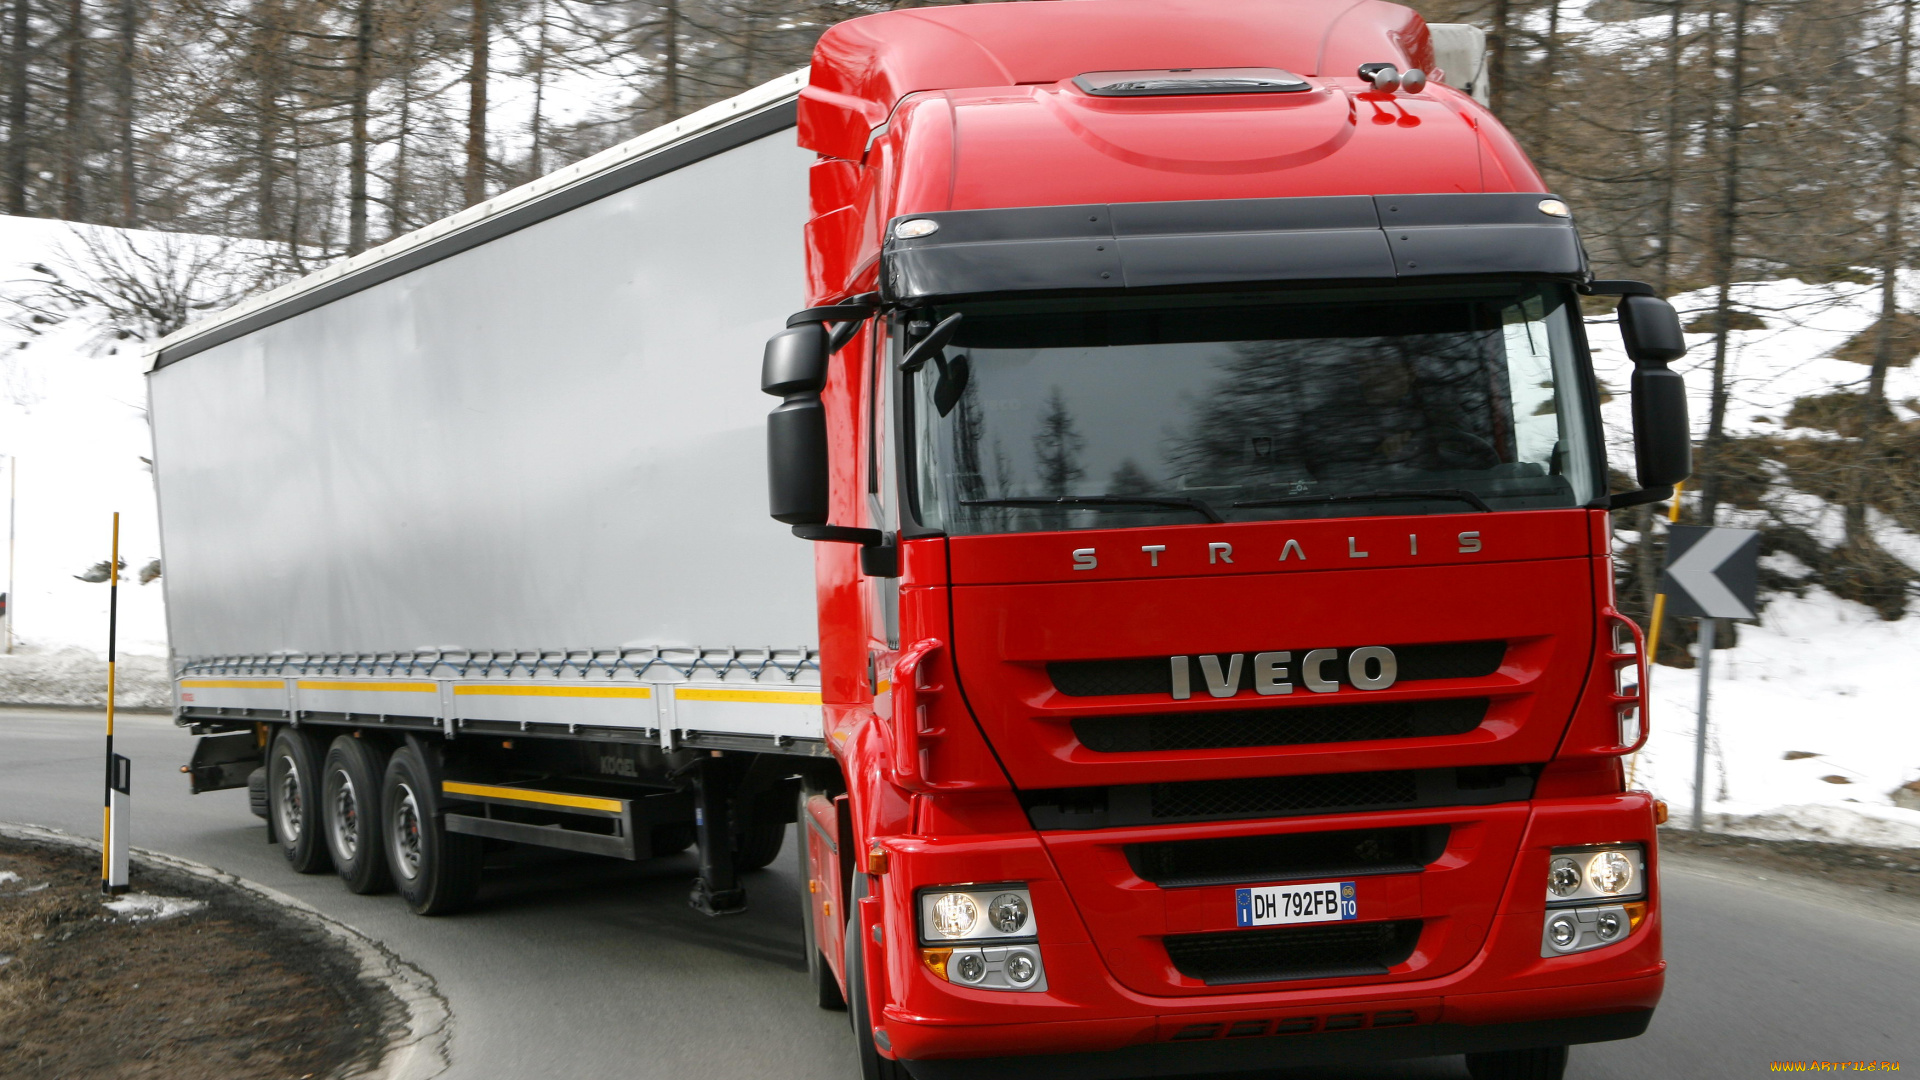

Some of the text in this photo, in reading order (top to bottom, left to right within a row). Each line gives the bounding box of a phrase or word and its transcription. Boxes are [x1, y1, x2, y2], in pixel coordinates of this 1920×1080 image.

[1072, 531, 1482, 570] STRALIS
[1170, 646, 1398, 700] IVECO
[1254, 894, 1276, 919] DH
[1282, 890, 1338, 917] 792FB
[1341, 900, 1357, 916] TO
